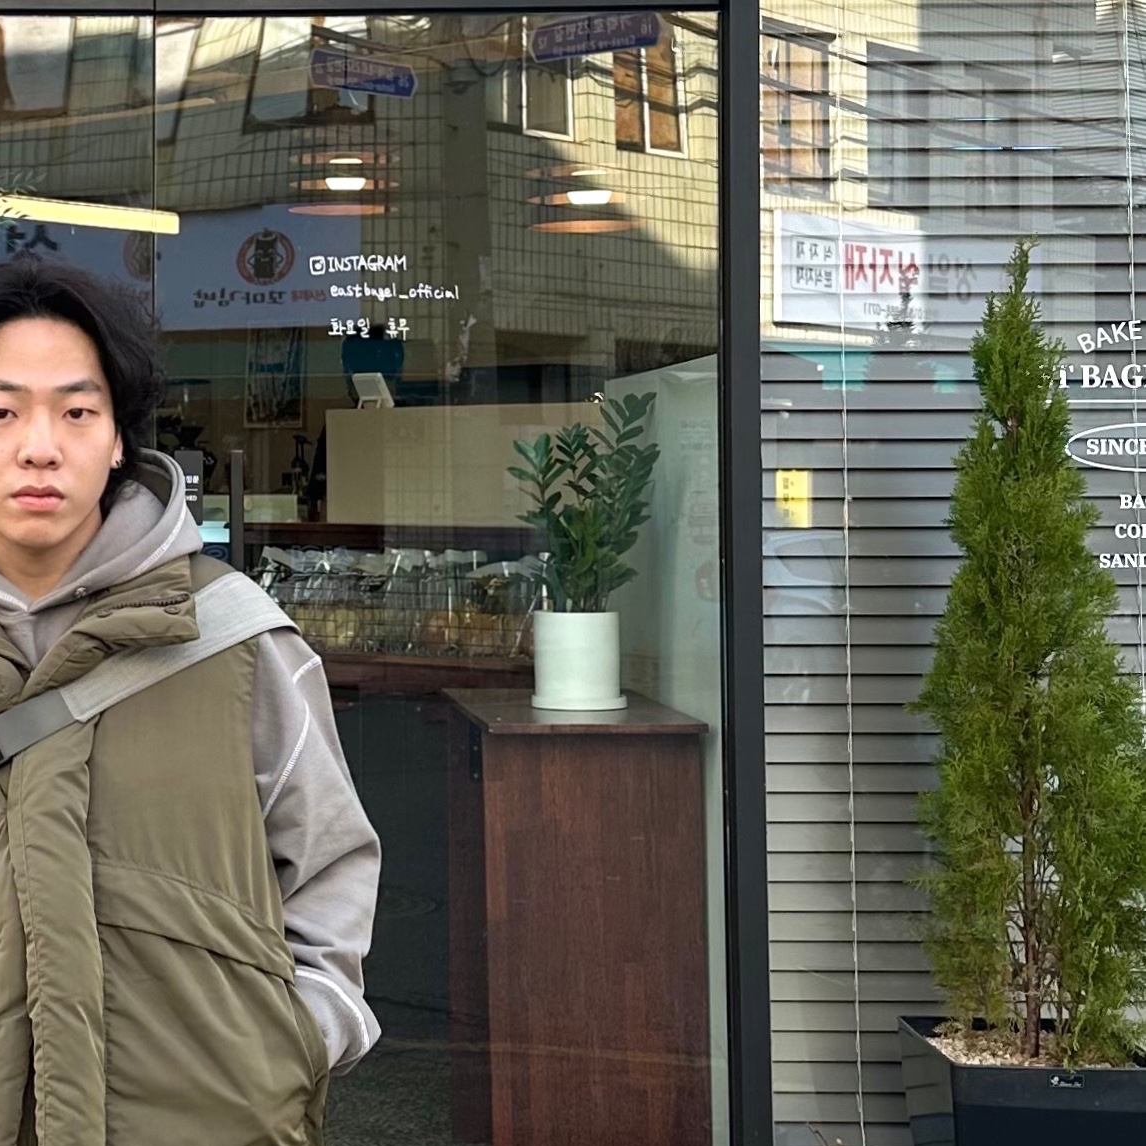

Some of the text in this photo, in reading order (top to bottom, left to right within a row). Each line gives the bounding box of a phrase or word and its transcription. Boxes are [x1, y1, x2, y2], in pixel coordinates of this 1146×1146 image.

[328, 255, 407, 273] INSTAGRAM
[329, 282, 460, 302] eastbagel_official
[328, 317, 410, 341] 화요일 휴무
[1076, 319, 1143, 355] BAKE
[1080, 363, 1146, 389] BAG
